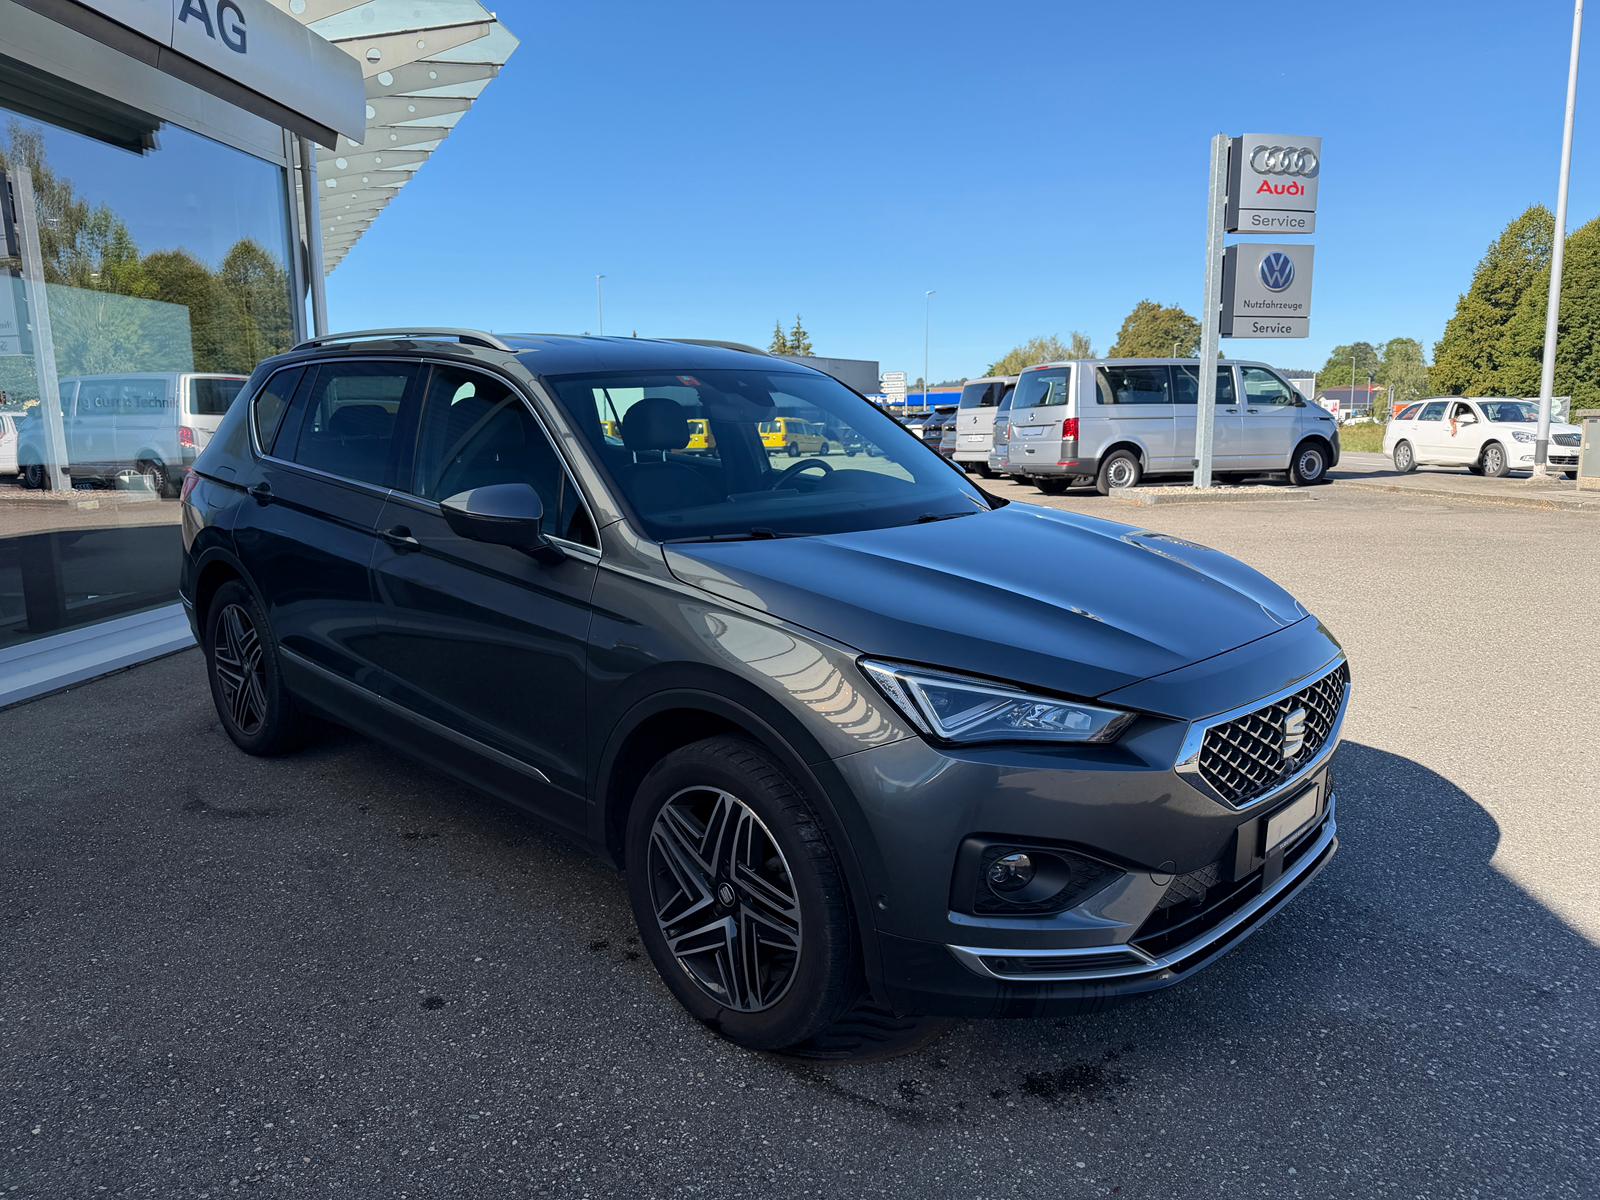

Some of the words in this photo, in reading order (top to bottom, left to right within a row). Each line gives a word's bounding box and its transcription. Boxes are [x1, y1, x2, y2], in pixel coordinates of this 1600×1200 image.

[177, 0, 247, 54] AG
[1256, 179, 1305, 196] Audi
[1251, 214, 1306, 228] Service
[1243, 299, 1303, 311] Nutzfahrzeuge
[1252, 321, 1292, 334] Service
